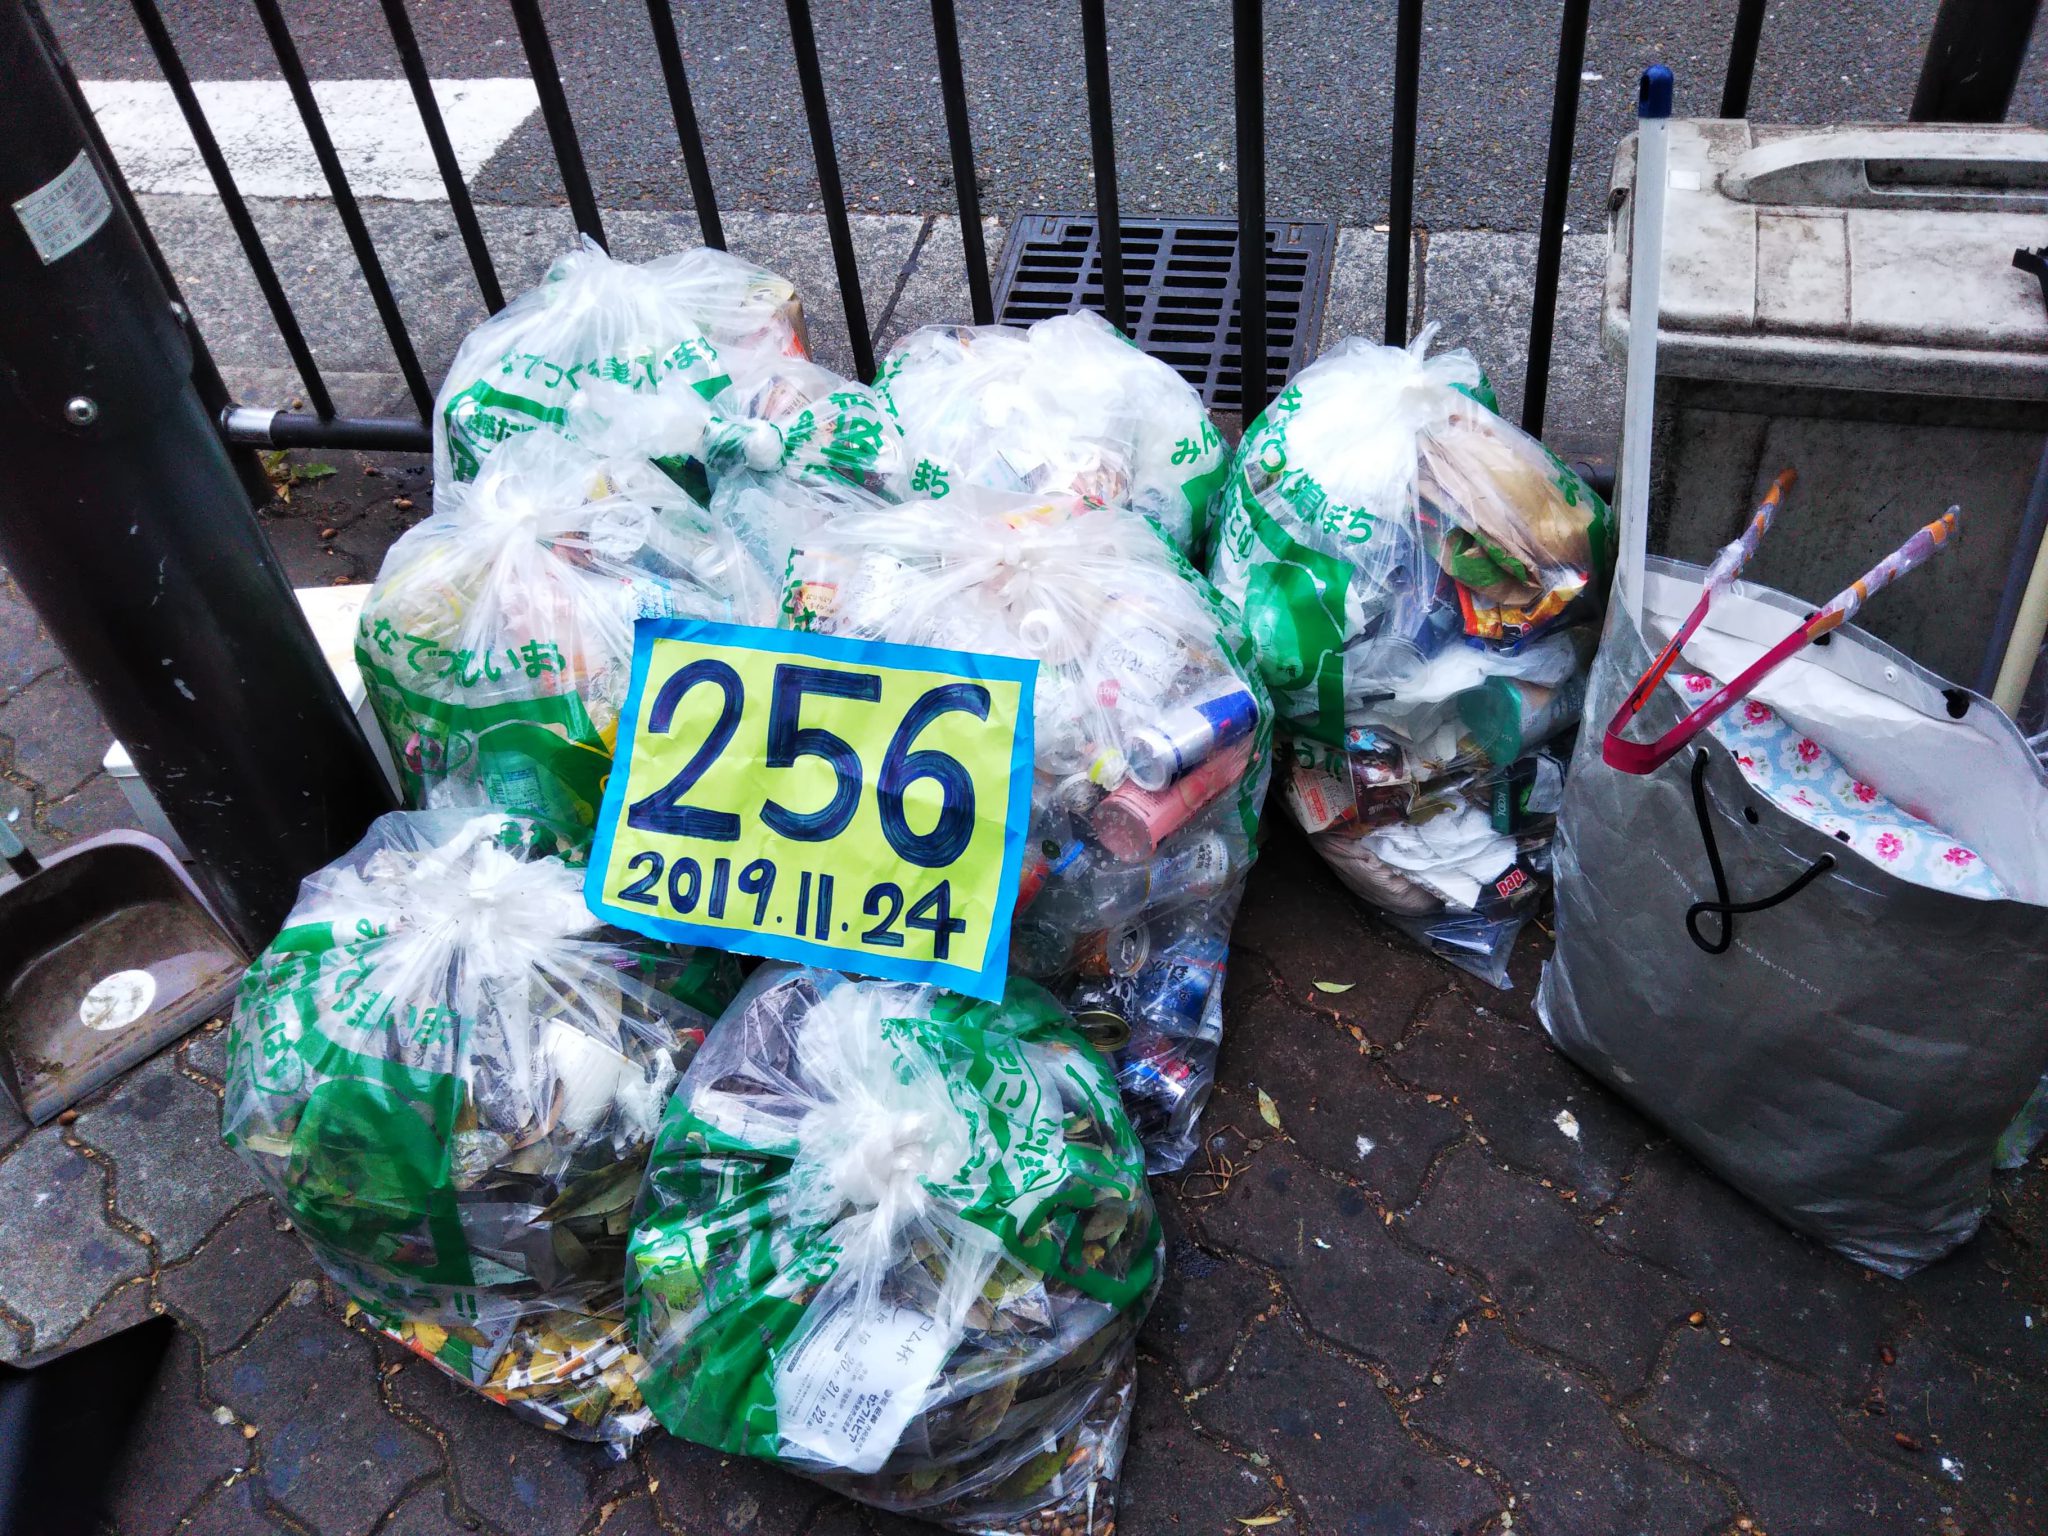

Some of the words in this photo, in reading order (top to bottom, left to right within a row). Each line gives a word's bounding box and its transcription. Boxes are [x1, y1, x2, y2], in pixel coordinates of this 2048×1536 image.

[912, 457, 950, 499] まち
[627, 659, 992, 869] 256
[1495, 791, 1509, 817] KOOL
[617, 851, 967, 960] 2019.11.24
[1734, 938, 1753, 954] Are
[1756, 952, 1796, 982] Having
[1799, 977, 1823, 995] Fun
